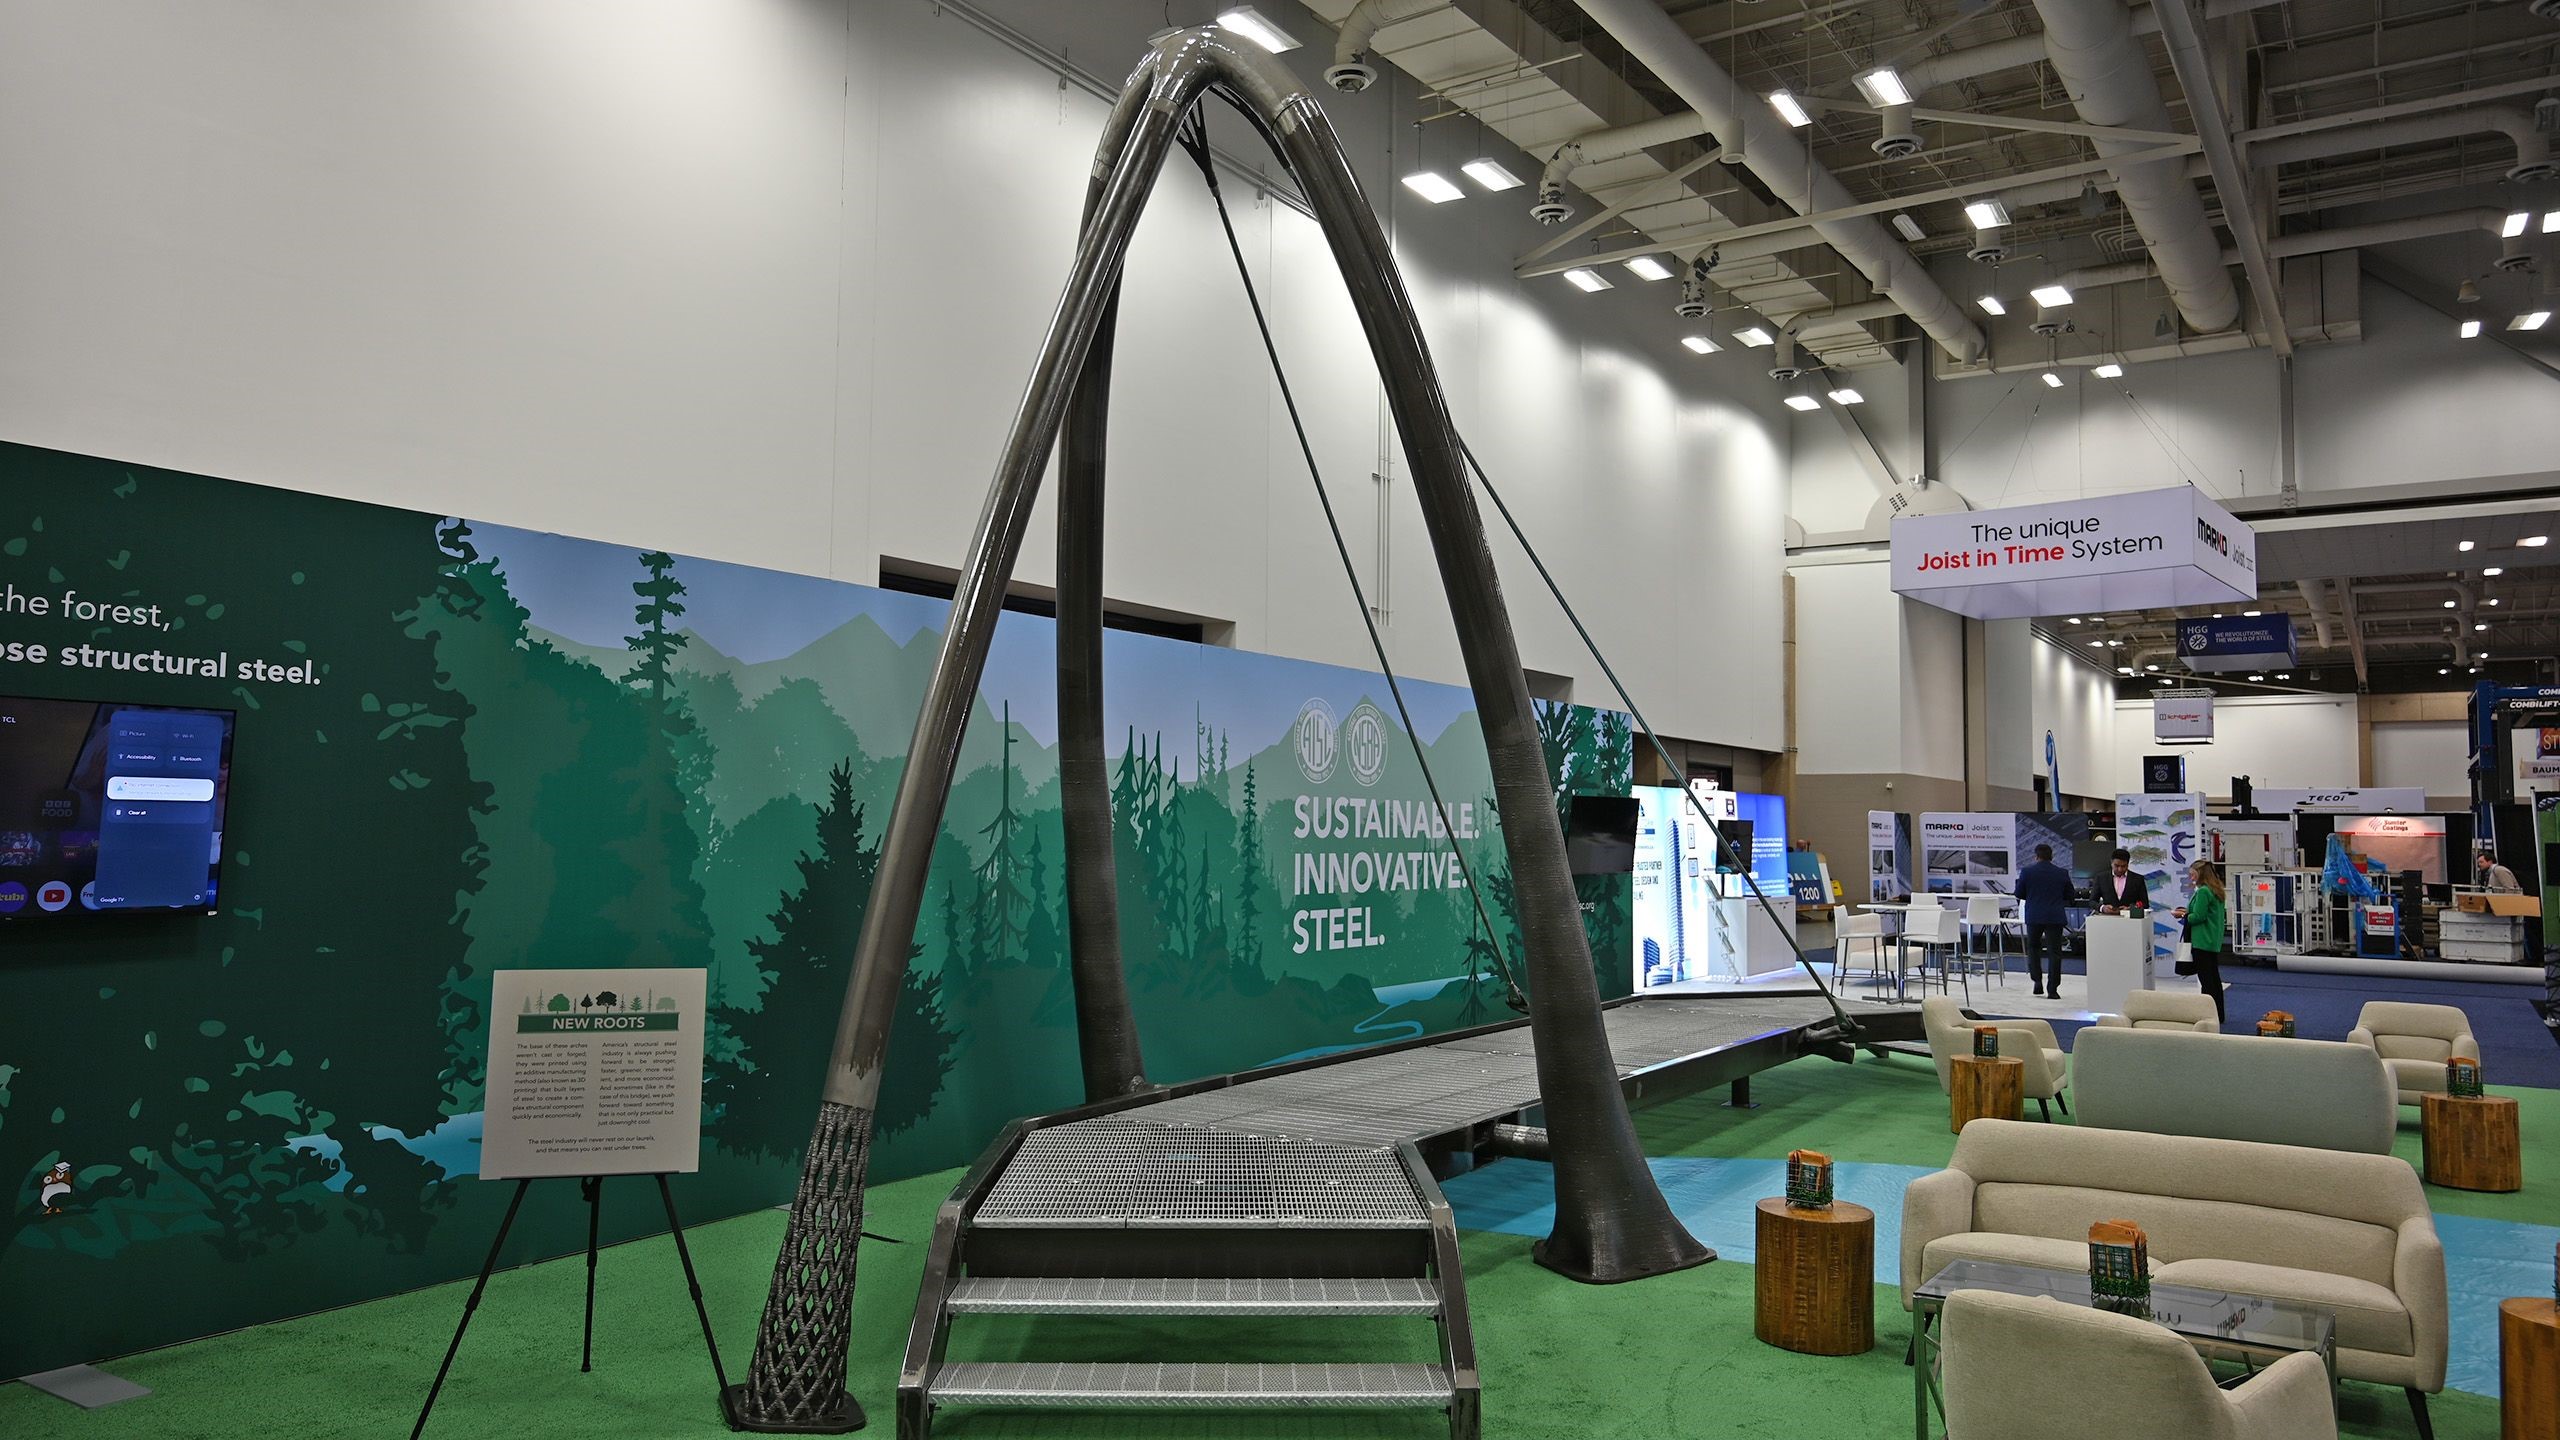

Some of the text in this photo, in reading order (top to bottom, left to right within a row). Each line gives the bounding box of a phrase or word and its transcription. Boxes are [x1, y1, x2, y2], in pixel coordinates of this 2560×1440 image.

[1971, 517, 2100, 543] The unique
[1917, 535, 2163, 571] Joist in Time System
[2198, 517, 2227, 557] MARKO
[2232, 544, 2246, 569] Joist
[61, 590, 170, 632] forest,
[2187, 625, 2208, 634] HGG
[60, 644, 228, 678] structural
[237, 659, 321, 686] steel.
[2, 716, 16, 724] TCL
[2543, 735, 2560, 750] ST
[126, 753, 157, 761] Accessibility
[42, 808, 73, 817] FOOD
[1293, 795, 1480, 839] SUSTAINABLE.
[1294, 851, 1468, 895] INNOVATIVE.
[1799, 887, 1820, 901] 1200
[1578, 902, 1595, 913] sc.org
[1293, 907, 1385, 954] STEEL.
[553, 1017, 645, 1030] NEW ROOTS
